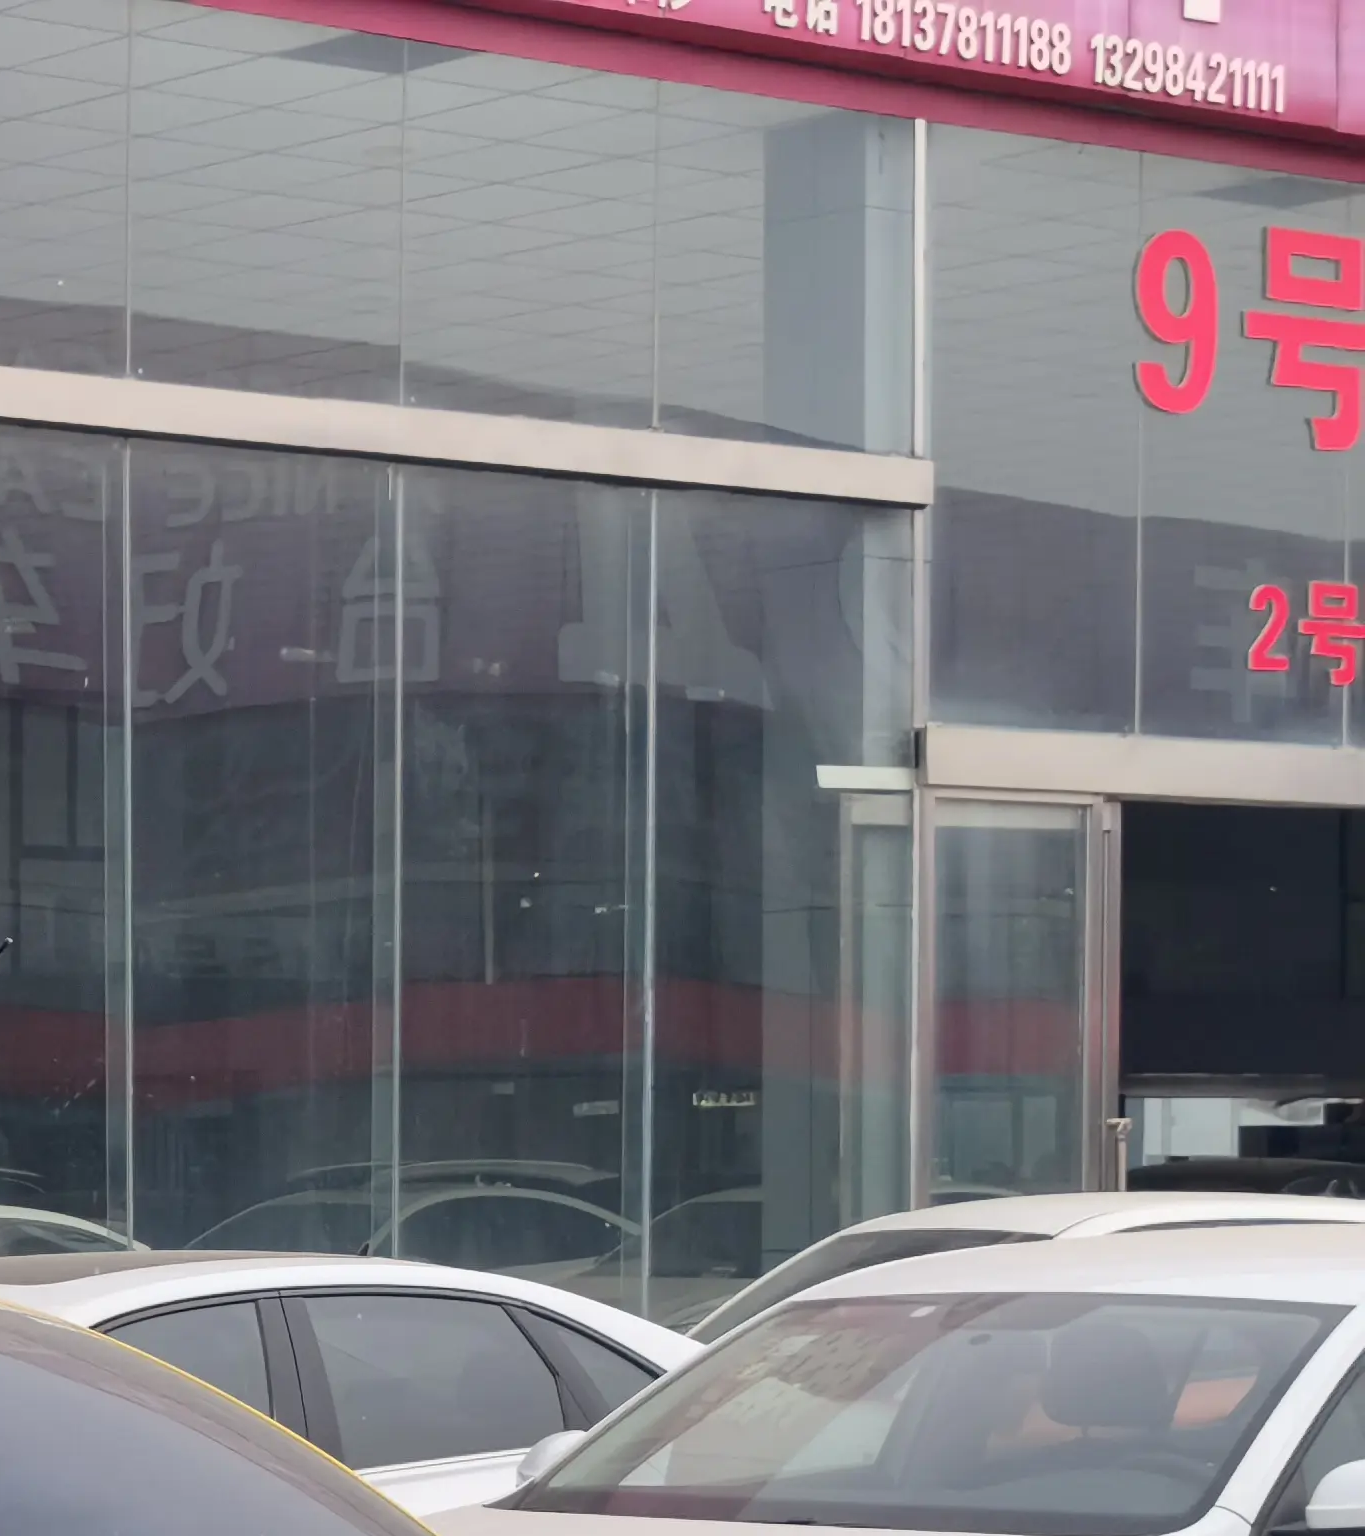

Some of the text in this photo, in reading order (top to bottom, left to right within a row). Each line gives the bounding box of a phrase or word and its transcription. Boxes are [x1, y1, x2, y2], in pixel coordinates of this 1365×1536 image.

[856, 0, 1073, 75] 18137811188
[1089, 33, 1286, 114] 13298421111
[1133, 226, 1365, 452] 9号
[1247, 580, 1365, 686] 2号
